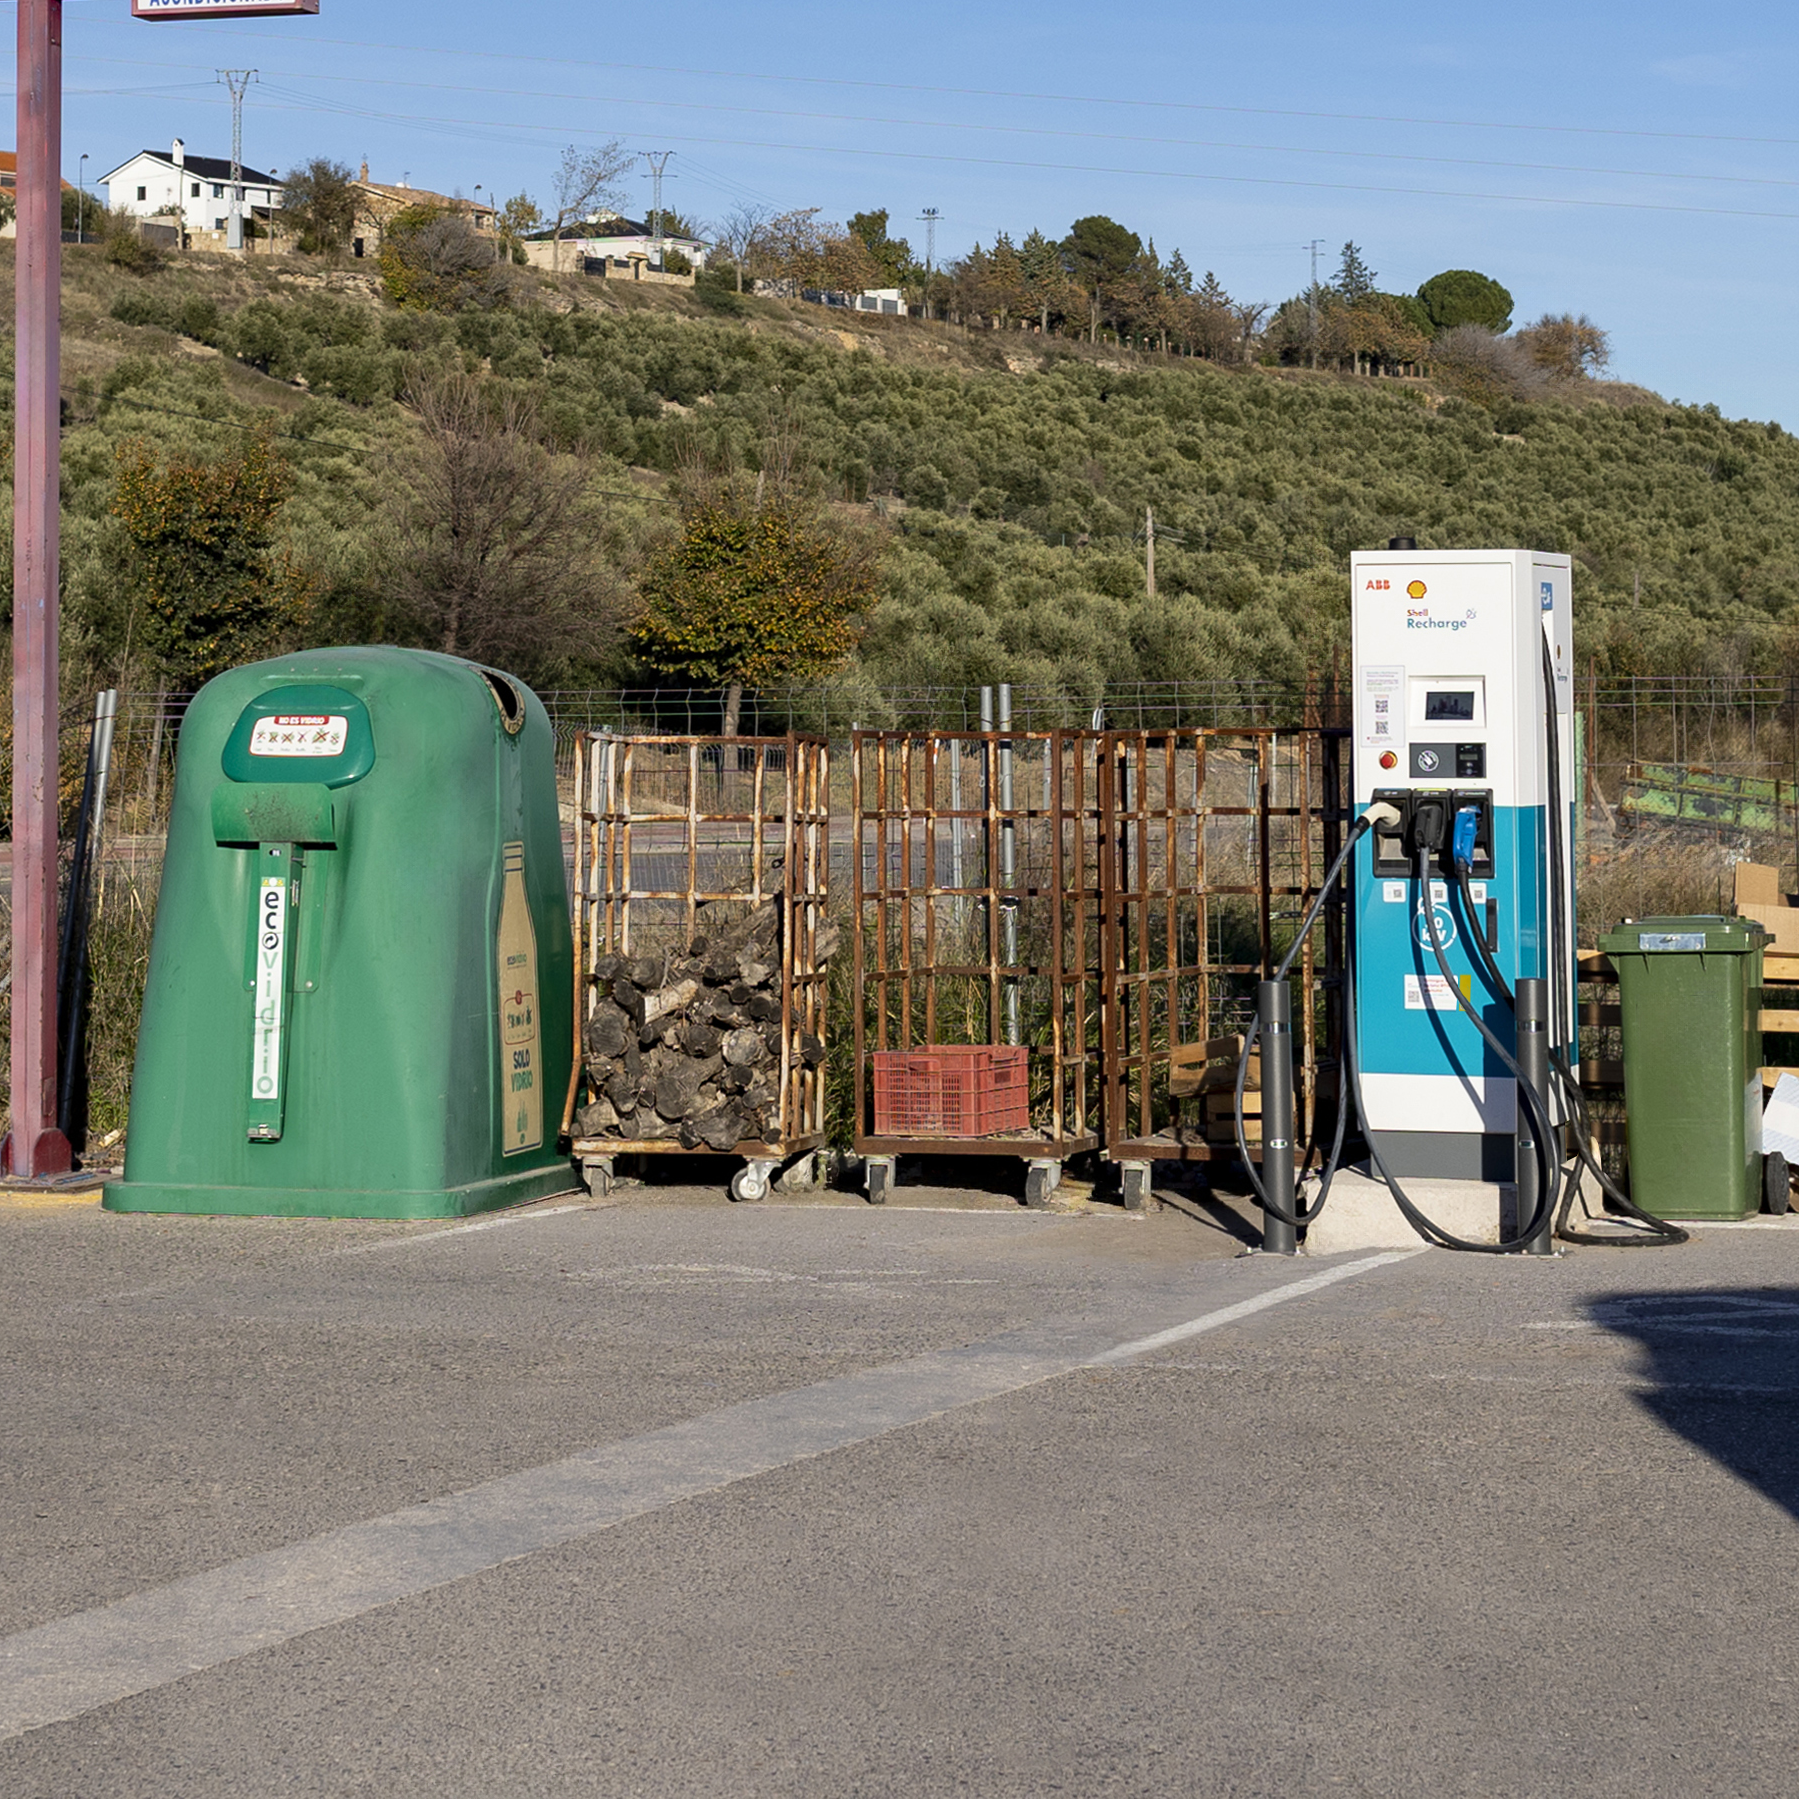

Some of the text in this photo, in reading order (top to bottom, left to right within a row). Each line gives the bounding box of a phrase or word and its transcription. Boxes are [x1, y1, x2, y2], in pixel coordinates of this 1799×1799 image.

[1365, 579, 1391, 591] ABB
[1407, 608, 1428, 616] Shell
[1407, 617, 1468, 631] Recharge
[513, 1048, 530, 1070] SOLO
[511, 1070, 533, 1093] VIDRIO
